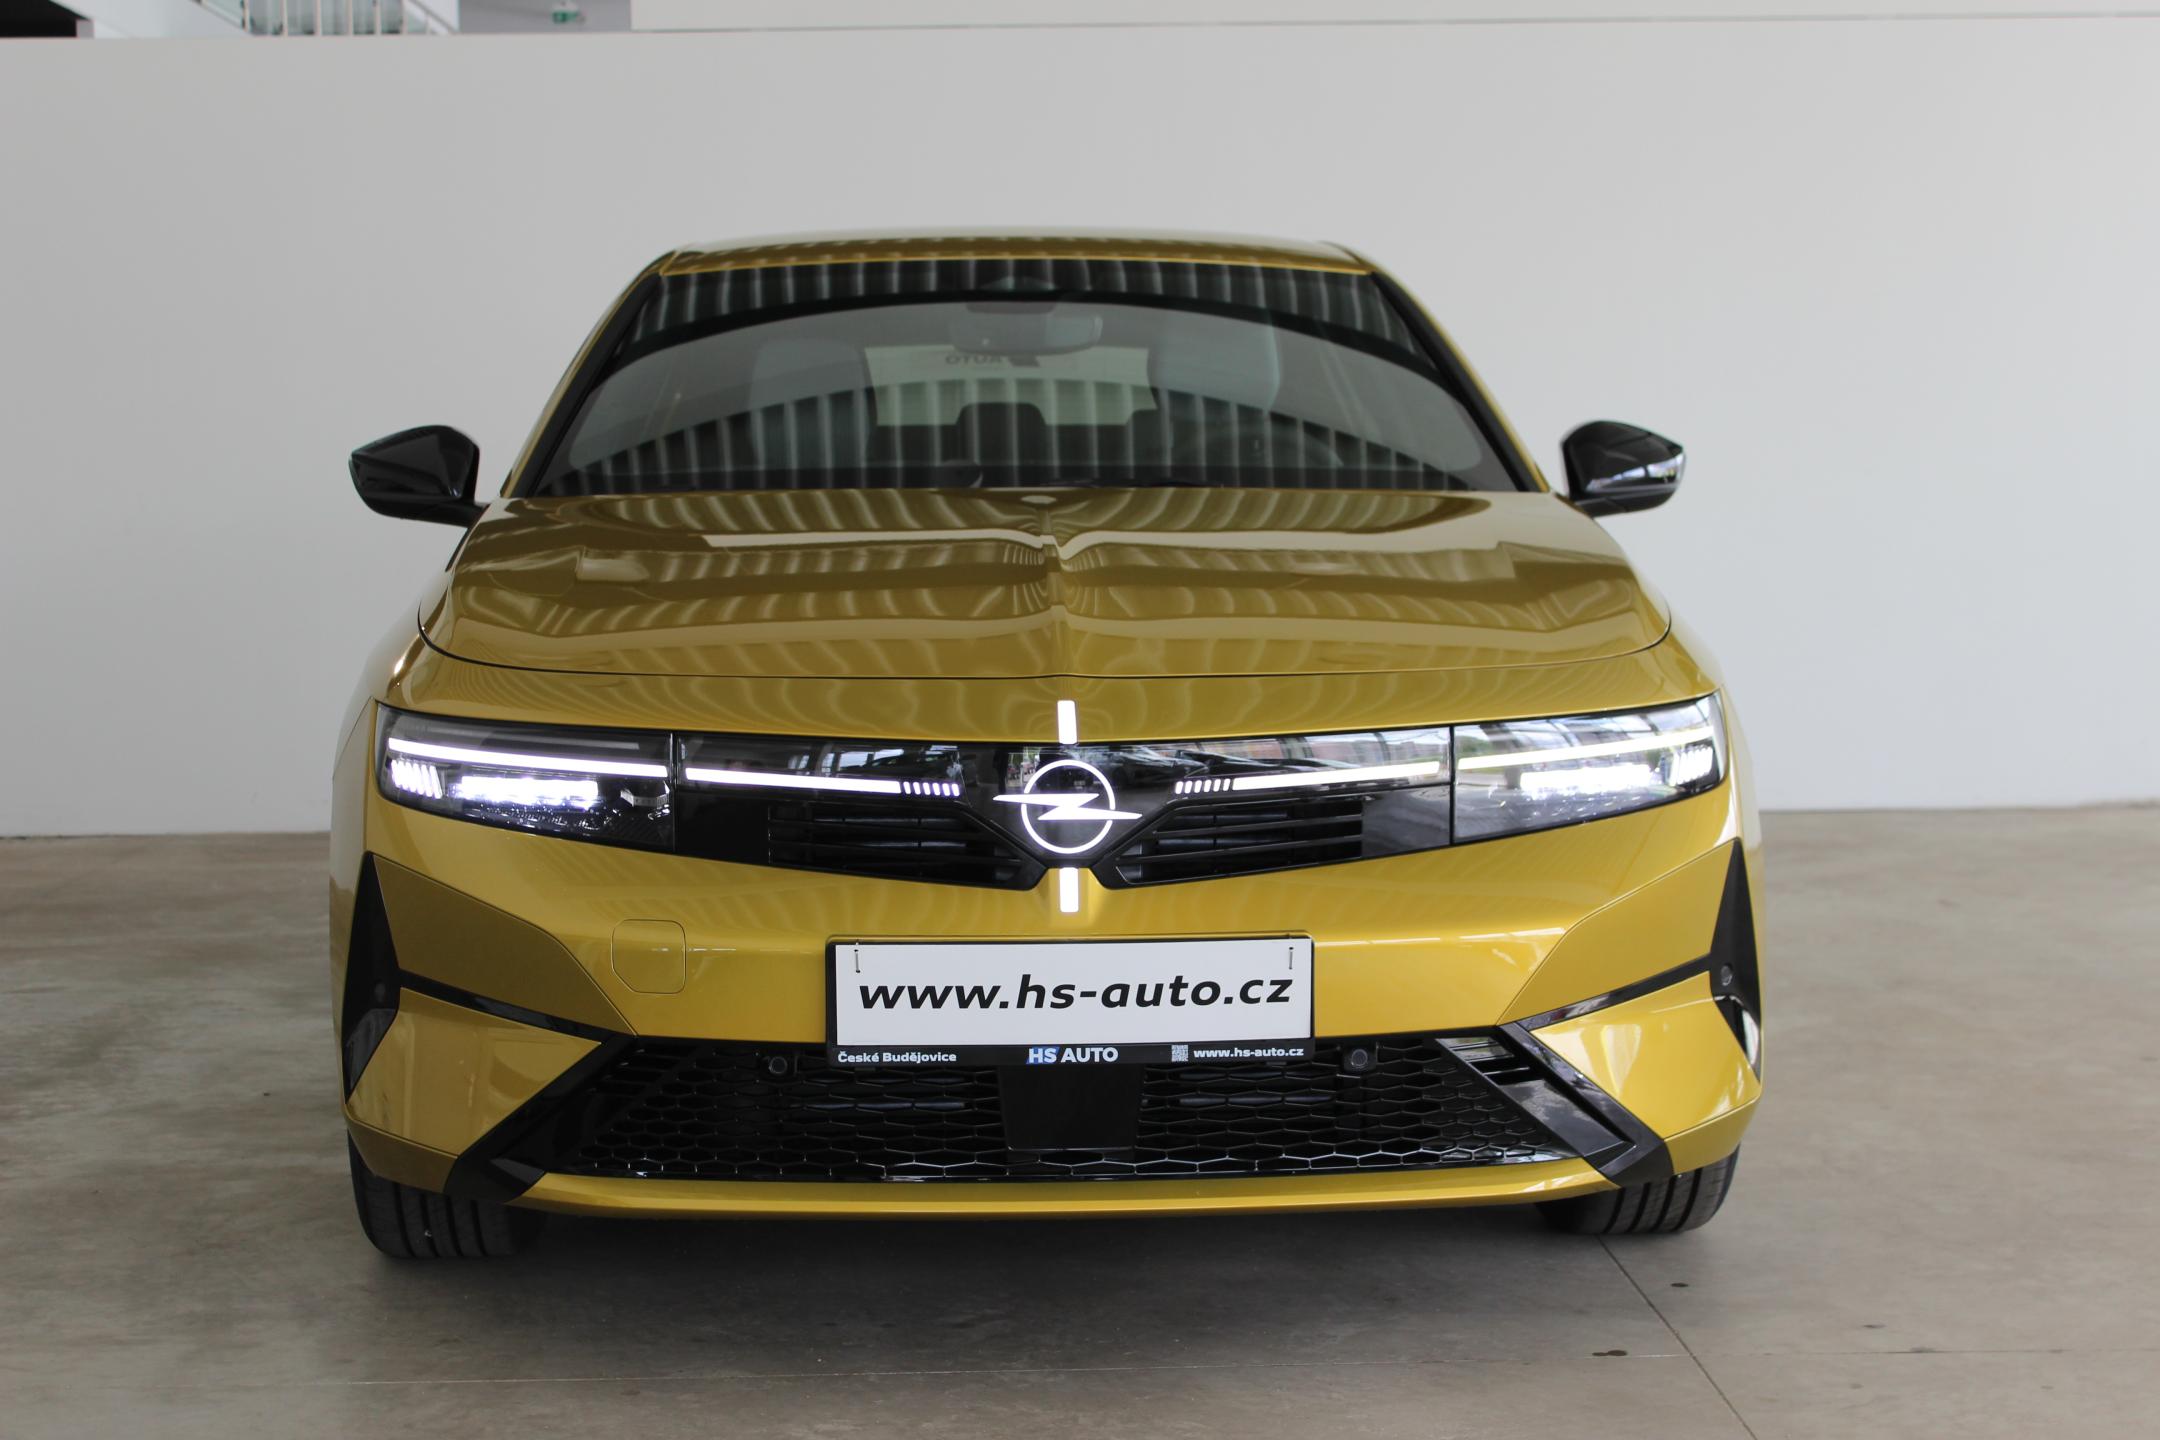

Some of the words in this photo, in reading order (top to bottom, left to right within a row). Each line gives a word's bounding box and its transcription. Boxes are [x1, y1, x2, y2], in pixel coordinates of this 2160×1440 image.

[859, 974, 1293, 1009] www.hs-auto.cz
[837, 1050, 880, 1063] České
[882, 1051, 957, 1064] Budějovice
[1028, 1047, 1057, 1063] HS
[1061, 1046, 1119, 1063] AUTO
[1193, 1046, 1304, 1058] www.hs-auto.cz
